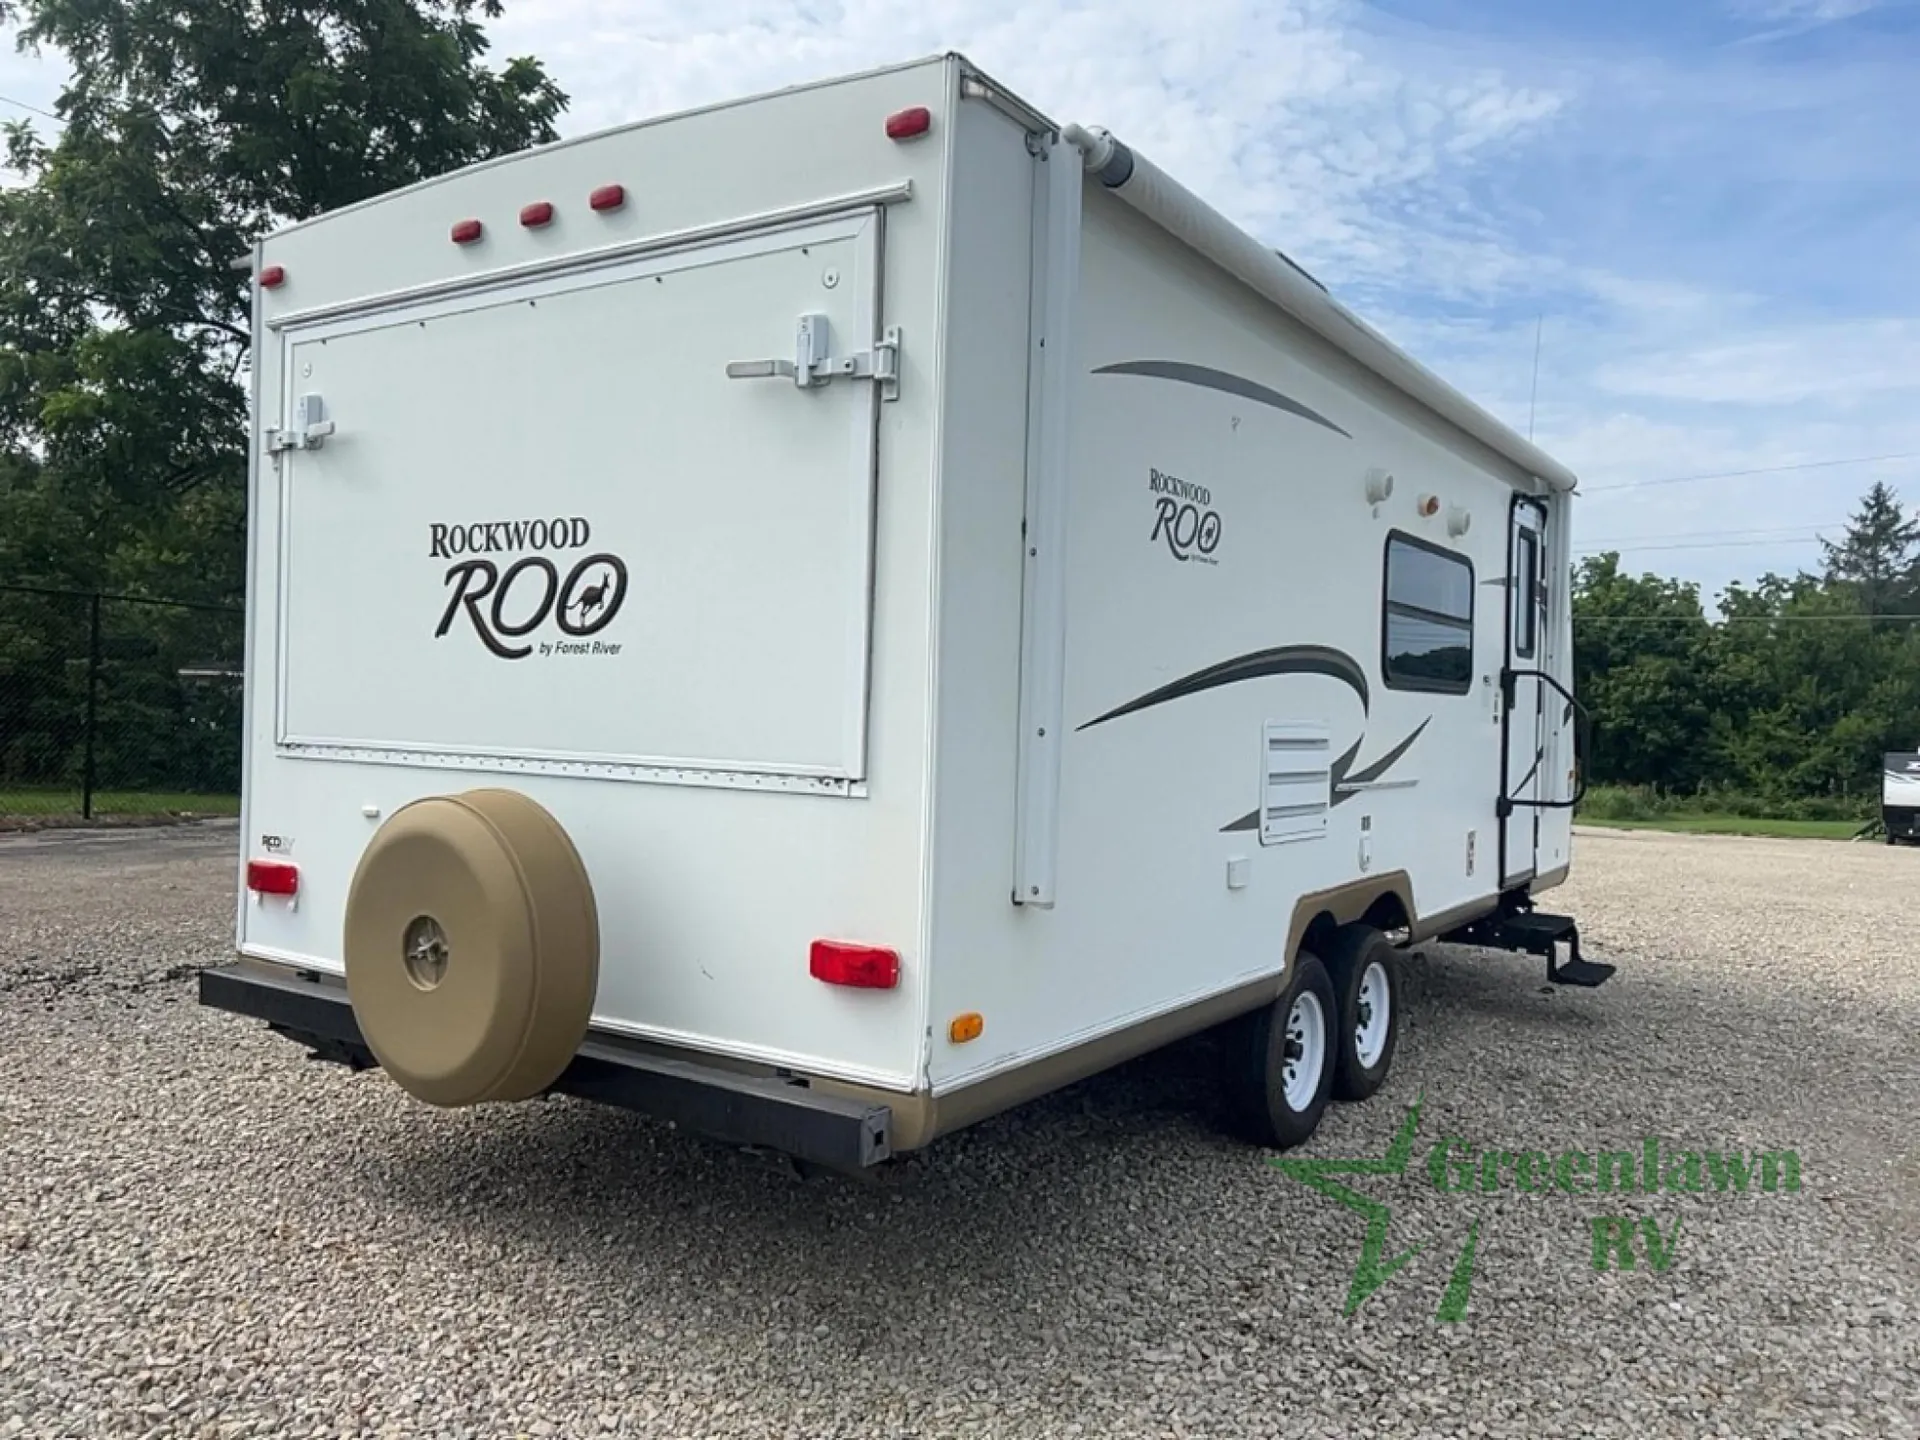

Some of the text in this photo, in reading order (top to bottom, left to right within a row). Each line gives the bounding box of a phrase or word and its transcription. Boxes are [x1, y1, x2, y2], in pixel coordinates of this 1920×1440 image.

[1149, 467, 1211, 505] ROCKWOOD
[429, 517, 590, 559] ROCKWOOD
[1151, 497, 1221, 561] ROO
[435, 553, 628, 659] ROO
[539, 641, 622, 657] by Forest River
